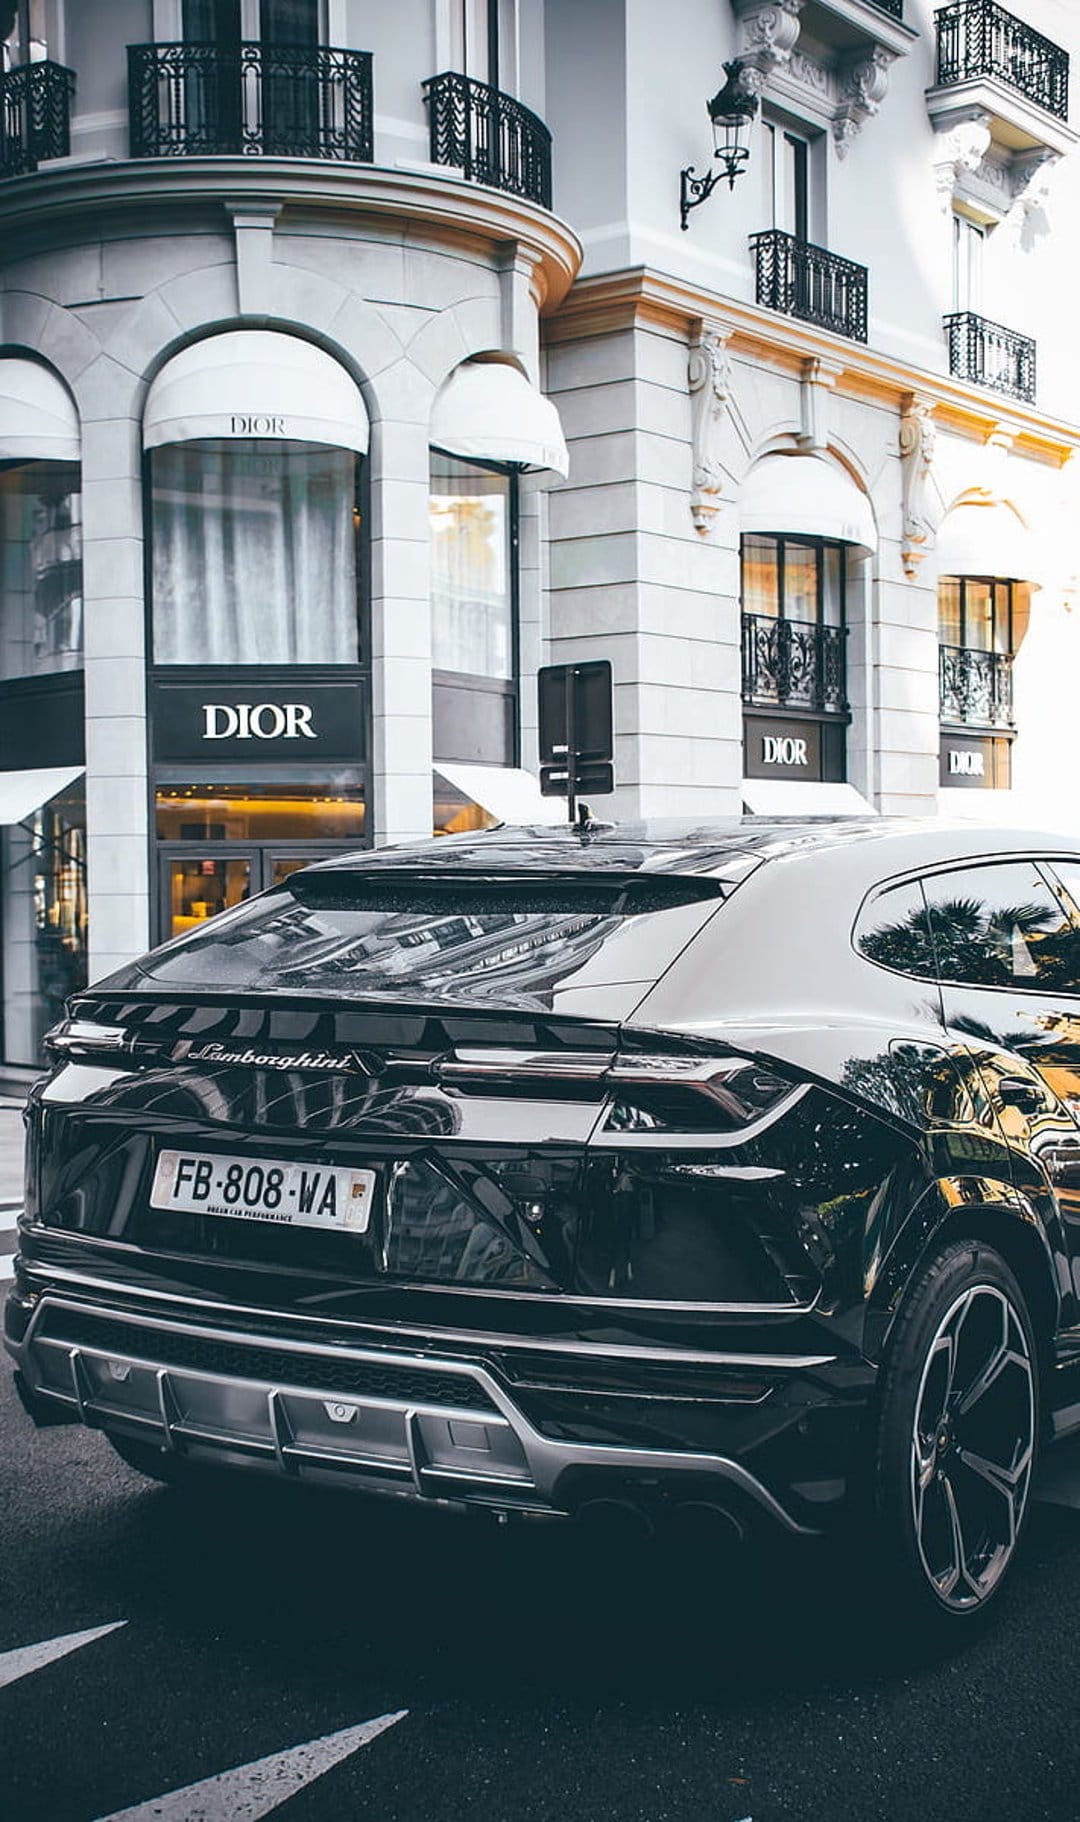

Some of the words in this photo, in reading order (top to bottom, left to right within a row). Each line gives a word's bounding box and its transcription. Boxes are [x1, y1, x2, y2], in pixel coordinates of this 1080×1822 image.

[231, 416, 286, 434] DIOR
[202, 704, 318, 739] DIOR
[762, 736, 808, 765] DIOR
[948, 751, 985, 776] DIOR
[188, 1043, 351, 1070] Lamborghini
